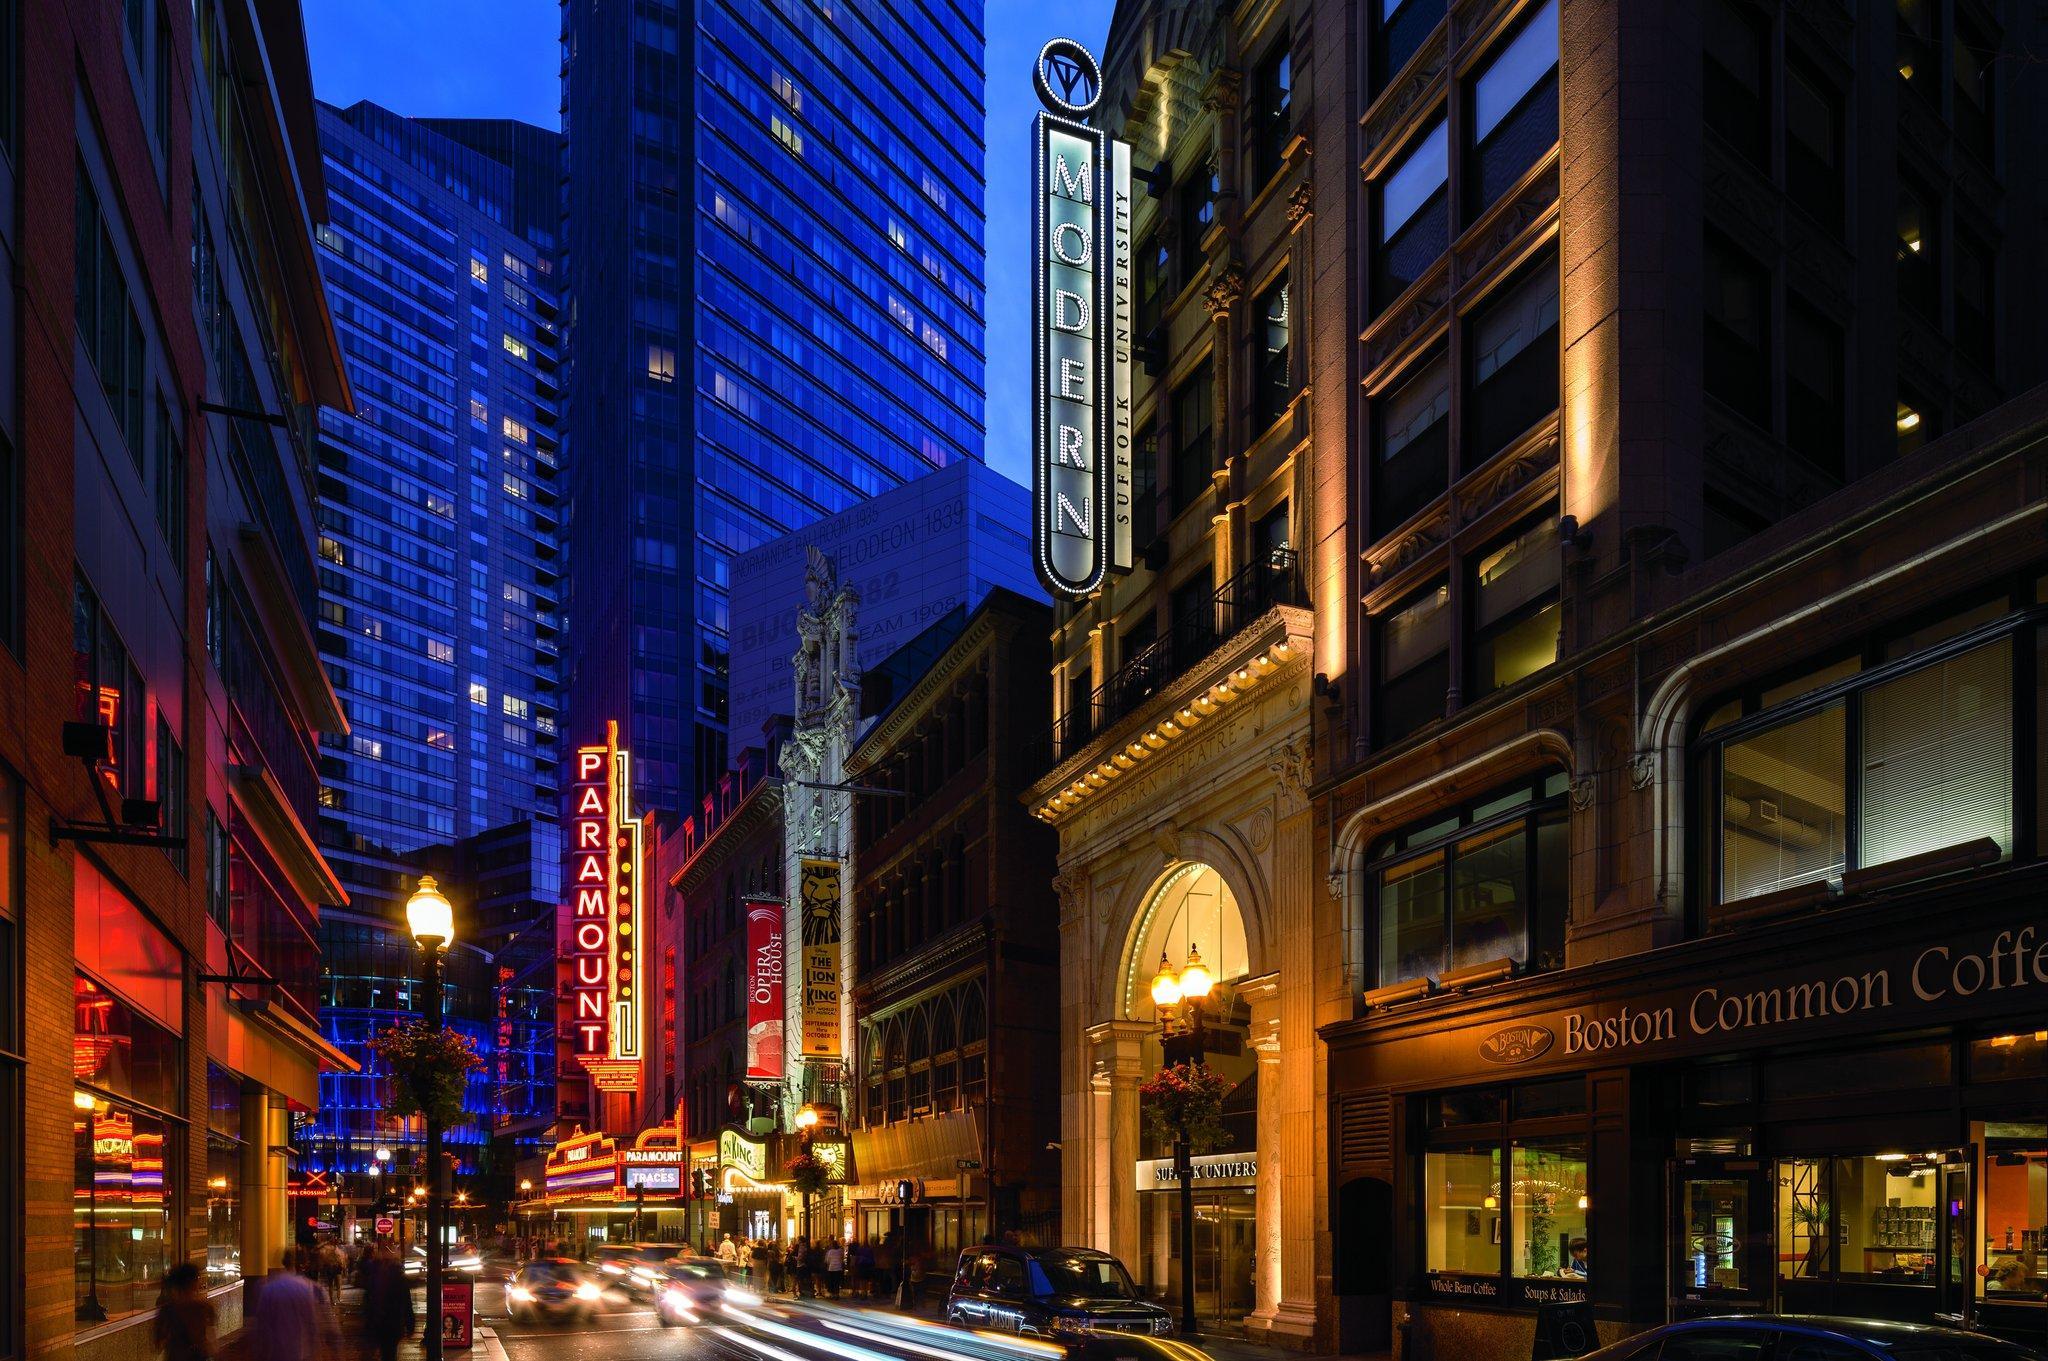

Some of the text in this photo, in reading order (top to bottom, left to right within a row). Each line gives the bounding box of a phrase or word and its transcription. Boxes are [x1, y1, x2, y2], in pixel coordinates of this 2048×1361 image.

[1051, 153, 1093, 538] MODERN
[1116, 190, 1129, 525] SUFFOLK UNIVERSITY
[925, 499, 964, 537] 1839
[911, 596, 957, 623] 1908
[576, 752, 605, 1055] PARAMOUNT
[770, 932, 782, 985] HOUSE
[810, 956, 832, 968] THE
[755, 944, 771, 1005] OPERA
[806, 968, 836, 987] LION
[806, 987, 837, 1007] KING
[1563, 1007, 1676, 1056] Boston
[1689, 967, 1894, 1036] Common
[1499, 1028, 1531, 1052] BOSTON
[626, 1151, 683, 1163] PARAMOUNT
[732, 1134, 752, 1166] KING
[632, 1172, 676, 1184] TRACES
[1430, 1279, 1497, 1296] Whole Bean Coffee
[1524, 1285, 1587, 1303] Soups & Salads
